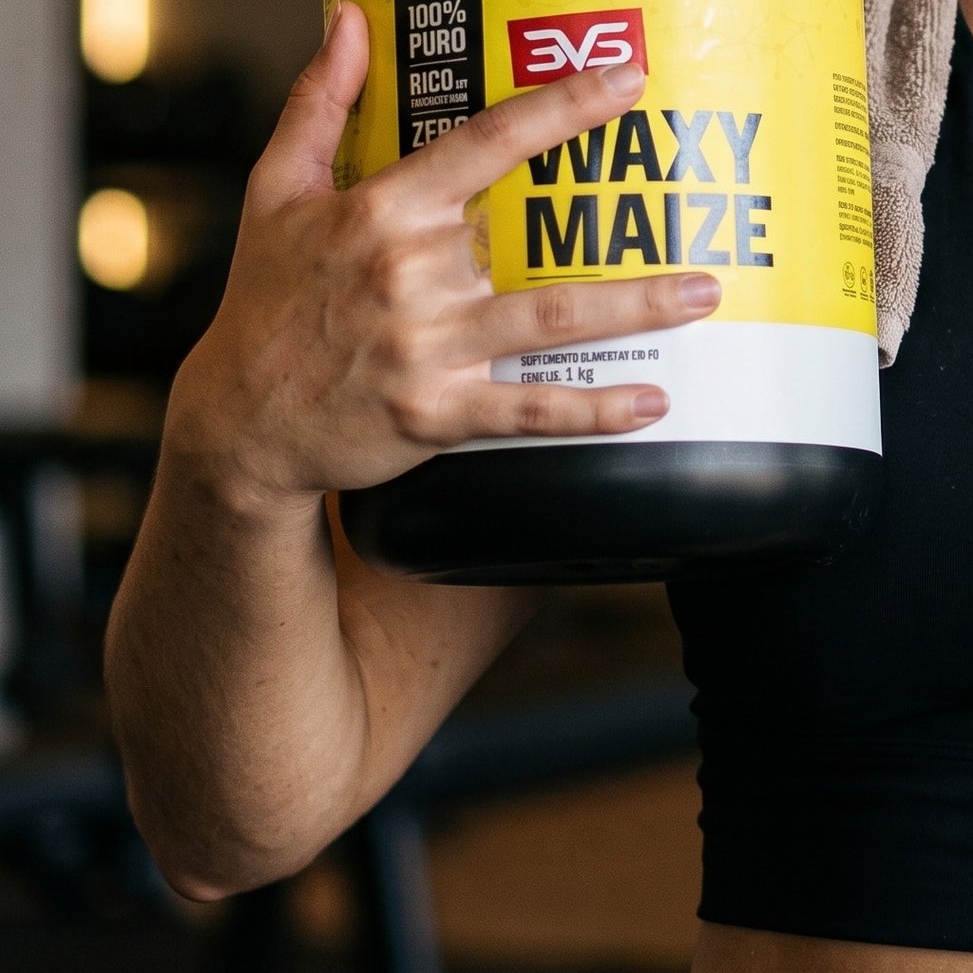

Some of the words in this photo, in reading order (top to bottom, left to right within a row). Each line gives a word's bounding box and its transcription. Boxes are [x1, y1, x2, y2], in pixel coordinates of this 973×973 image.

[408, 0, 467, 30] 100%
[409, 27, 467, 59] PURO
[410, 68, 453, 96] RICO
[526, 193, 774, 269] MAIZE
[565, 367, 574, 382] 1
[577, 366, 595, 384] kg
